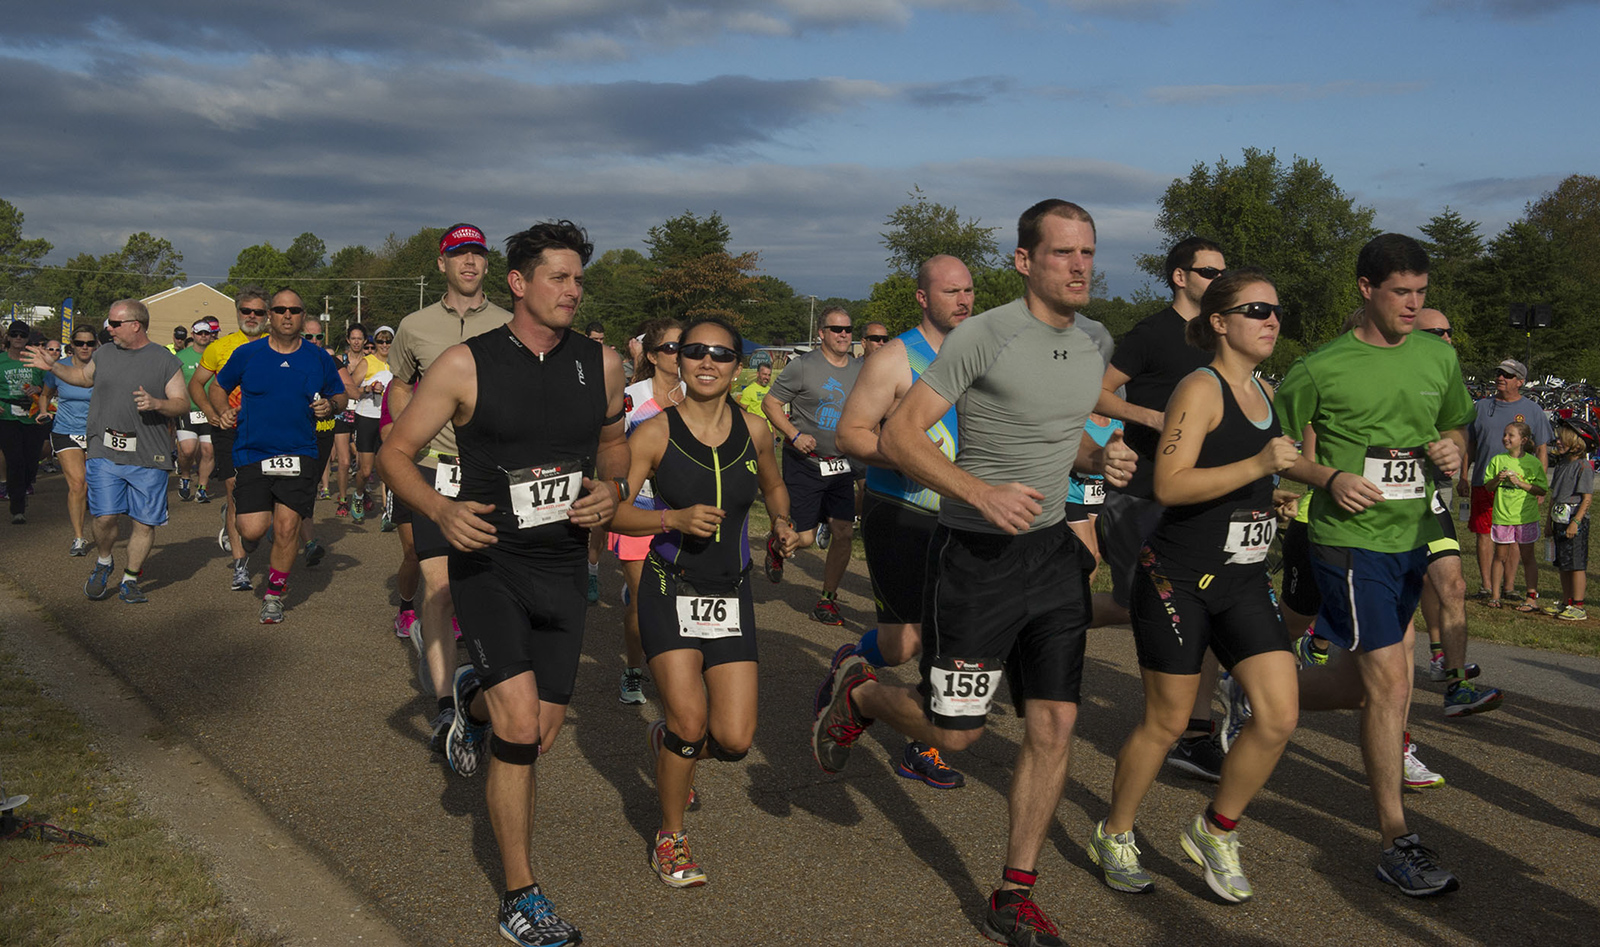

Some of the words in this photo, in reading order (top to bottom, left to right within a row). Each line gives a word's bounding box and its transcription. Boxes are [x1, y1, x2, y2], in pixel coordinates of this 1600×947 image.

[111, 436, 127, 449] 85
[1163, 411, 1186, 456] 130
[269, 457, 294, 469] 143
[827, 460, 845, 472] 173
[1381, 460, 1416, 483] 131
[529, 476, 571, 508] 177
[1240, 521, 1273, 547] 130
[690, 598, 727, 622] 176
[943, 673, 990, 697] 158
